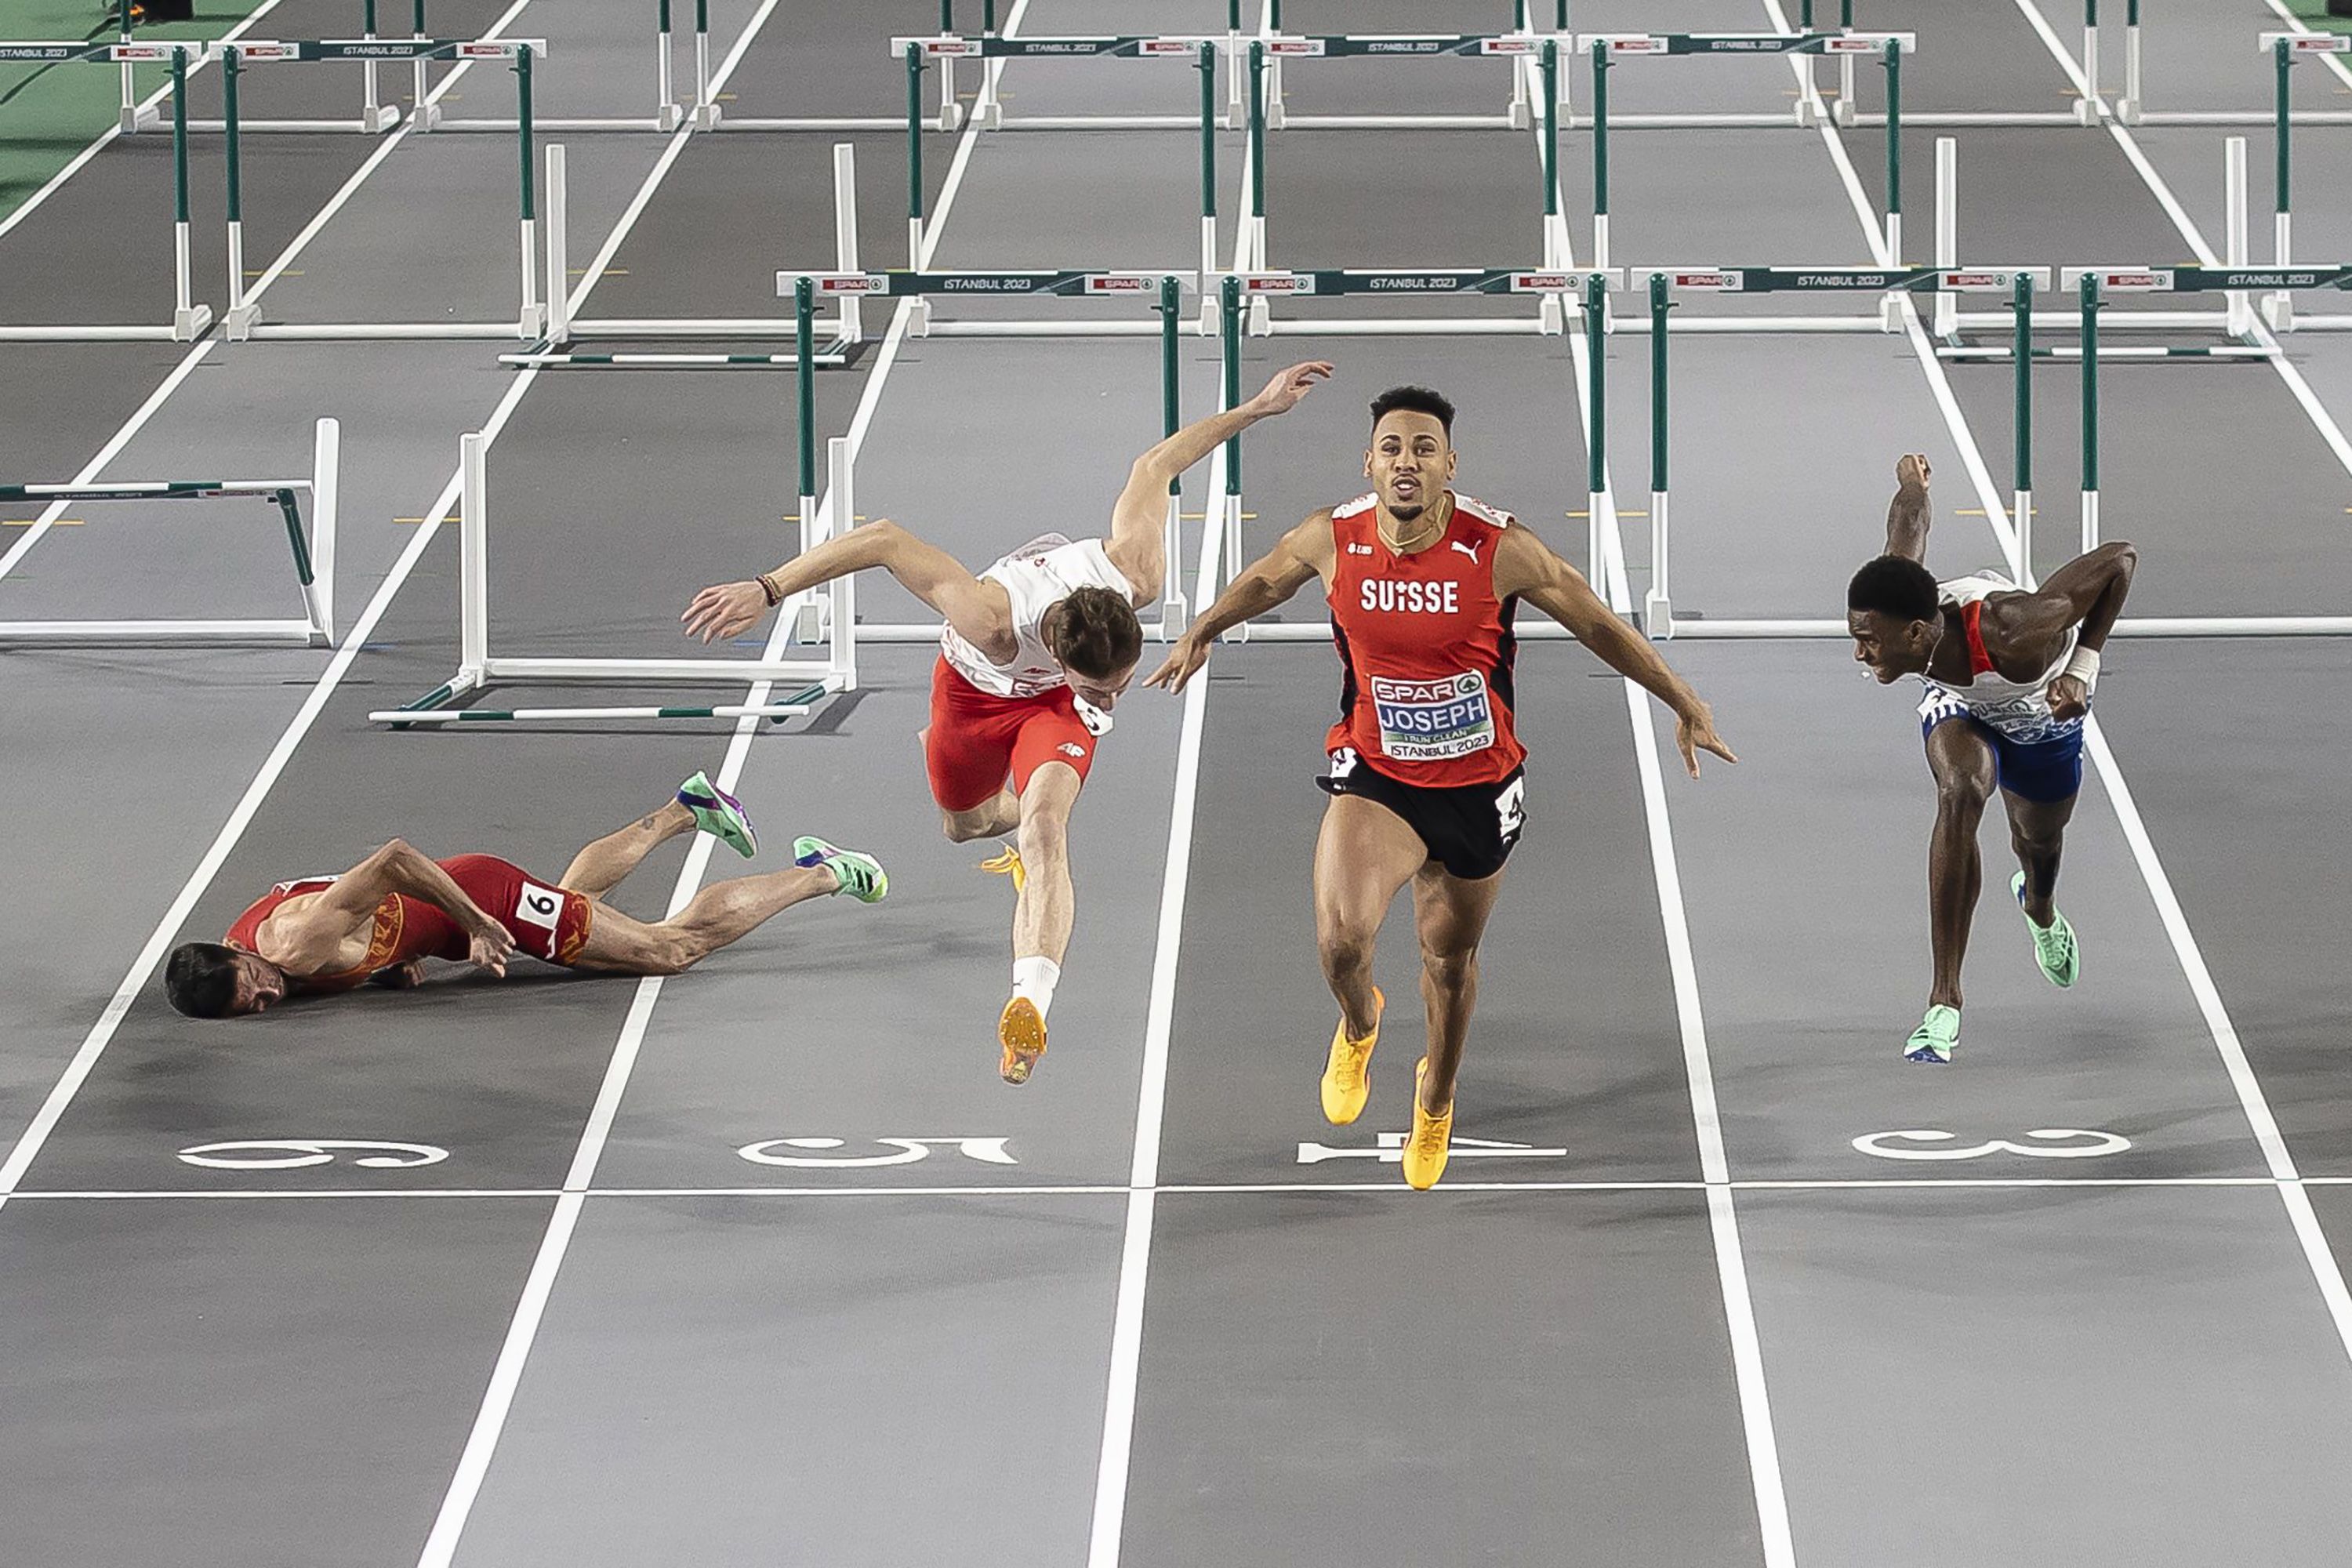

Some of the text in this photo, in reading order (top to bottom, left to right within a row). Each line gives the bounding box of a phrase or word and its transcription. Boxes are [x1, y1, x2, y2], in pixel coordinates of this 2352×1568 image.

[833, 279, 869, 290] SPAR
[944, 279, 1031, 289] ISTANBUL 2023
[1104, 279, 1140, 289] SPAR
[1259, 279, 1295, 289] SPAR
[1370, 278, 1457, 289] ISTANBUL 2023
[1530, 277, 1565, 287] SPAR
[1687, 275, 1723, 286] SPAR
[1797, 275, 1885, 286] ISTANBUL 2023
[2227, 274, 2315, 285] ISTANBUL 2023
[1377, 683, 1454, 701] SPAR
[1381, 697, 1486, 732] JOSEPH
[1433, 729, 1468, 742] CLEAN
[1391, 735, 1490, 757] ISTANBUL 2023
[1852, 1130, 2132, 1160] 3
[737, 1137, 1019, 1167] 5
